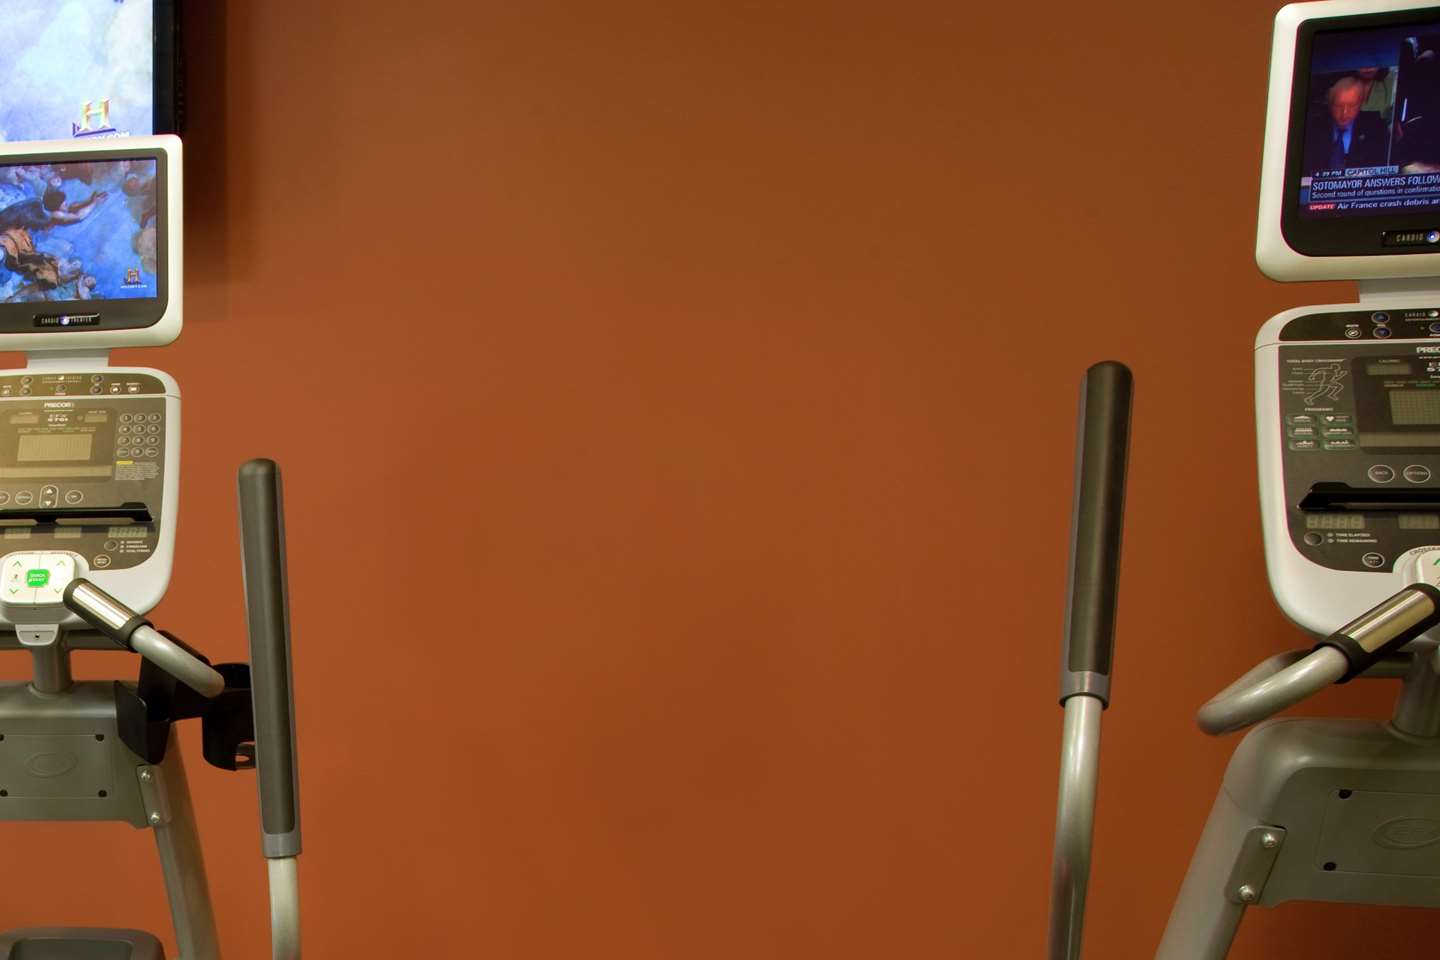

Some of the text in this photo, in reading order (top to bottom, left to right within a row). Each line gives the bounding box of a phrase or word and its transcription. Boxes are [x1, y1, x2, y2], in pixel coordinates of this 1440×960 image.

[1312, 180, 1362, 191] SOTOMAYOR
[1364, 176, 1406, 188] ANSWERS
[1311, 190, 1336, 199] Second
[1365, 188, 1396, 196] questions
[1337, 202, 1349, 210] Air
[1350, 201, 1378, 209] France
[1380, 199, 1401, 207] crash
